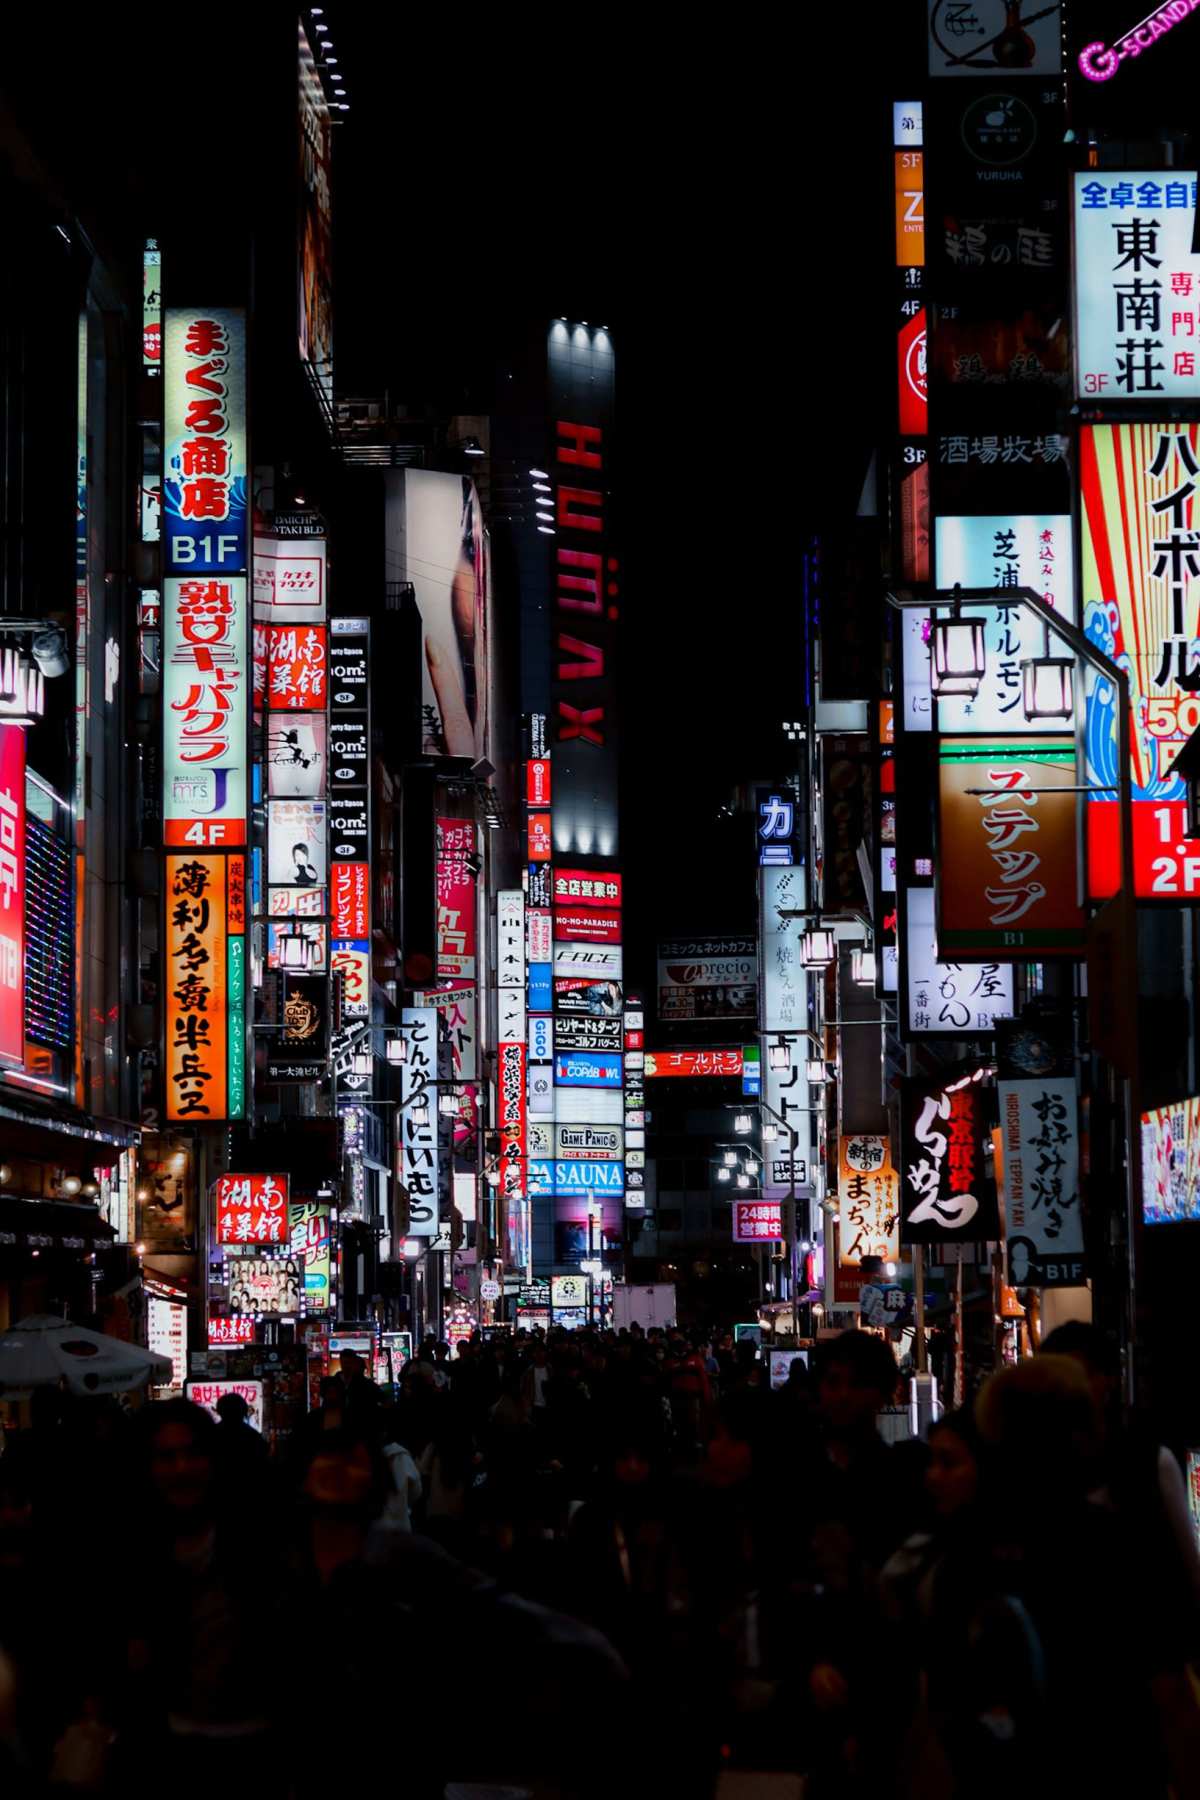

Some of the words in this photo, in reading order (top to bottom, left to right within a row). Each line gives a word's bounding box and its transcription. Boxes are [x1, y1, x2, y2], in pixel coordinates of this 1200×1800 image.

[902, 153, 921, 168] 5F
[976, 170, 1023, 181] YURUHA
[900, 300, 920, 315] 4F
[941, 307, 960, 319] 2F
[1111, 217, 1165, 394] 東南荘
[1171, 272, 1195, 376] 専門店
[1084, 373, 1109, 393] 3F
[182, 319, 230, 520] まぐろ商店
[903, 446, 927, 463] 3F
[939, 435, 1065, 464] 酒場牧場
[304, 526, 325, 535] BLD
[171, 535, 239, 564] B1F
[1149, 433, 1200, 688] ハイボール
[991, 528, 1020, 713] 芝浦ホルモン
[170, 581, 239, 763] 熟女キャバクラ
[288, 696, 308, 707] 4F
[172, 783, 208, 799] mrs
[184, 821, 226, 846] 4F
[979, 769, 1047, 925] ステップ
[1151, 856, 1200, 892] 2F
[555, 877, 618, 899] 全店営業中
[337, 865, 352, 938] リフレッシュ
[338, 941, 355, 951] 1F
[1003, 932, 1024, 944] B1
[556, 951, 620, 964] FACE
[969, 964, 1006, 999] 屋
[914, 979, 931, 1029] 一番街
[535, 1020, 546, 1057] GiGO
[1006, 1093, 1020, 1152] HIROSHIMA
[561, 1129, 584, 1145] GAME
[585, 1129, 609, 1146] PANIC
[847, 1143, 883, 1163] 新宿
[555, 1163, 623, 1185] SAUNA
[859, 1161, 872, 1170] の
[1027, 1091, 1077, 1238] お好み焼き
[1009, 1159, 1025, 1228] TEPPANYAKI
[740, 1205, 782, 1220] 24時間
[846, 1173, 873, 1256] まっちゃん
[740, 1221, 782, 1236] 営業中
[1046, 1263, 1083, 1280] B1F
[306, 1297, 324, 1307] 3F
